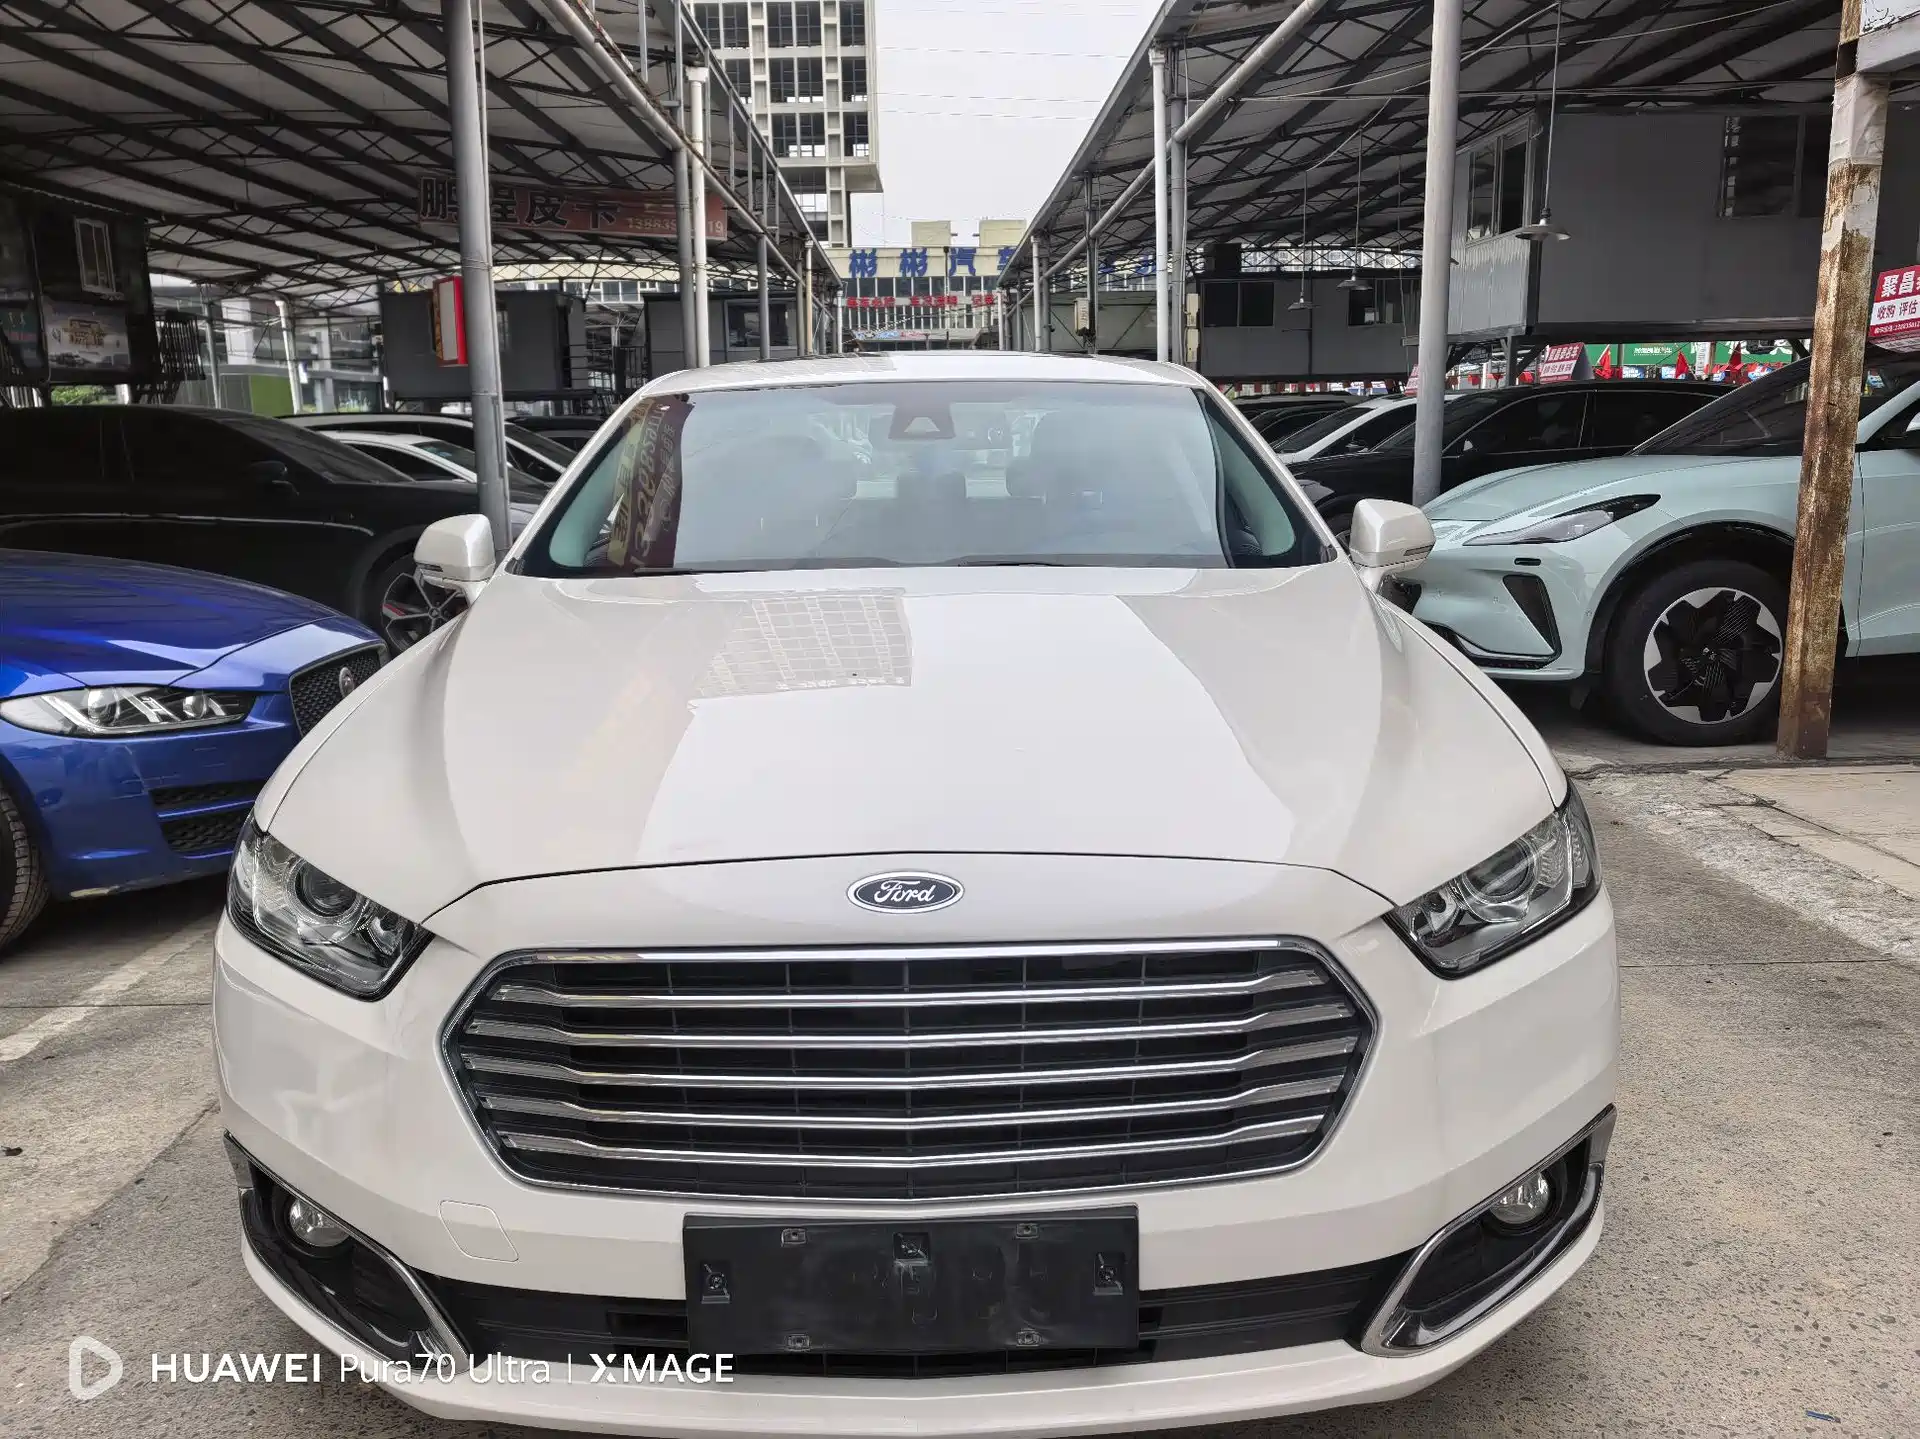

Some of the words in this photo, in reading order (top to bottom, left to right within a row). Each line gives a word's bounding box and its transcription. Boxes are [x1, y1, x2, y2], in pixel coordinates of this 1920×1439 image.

[1880, 270, 1920, 298] 聚昌
[1899, 299, 1919, 316] 评估
[874, 880, 937, 903] Ford
